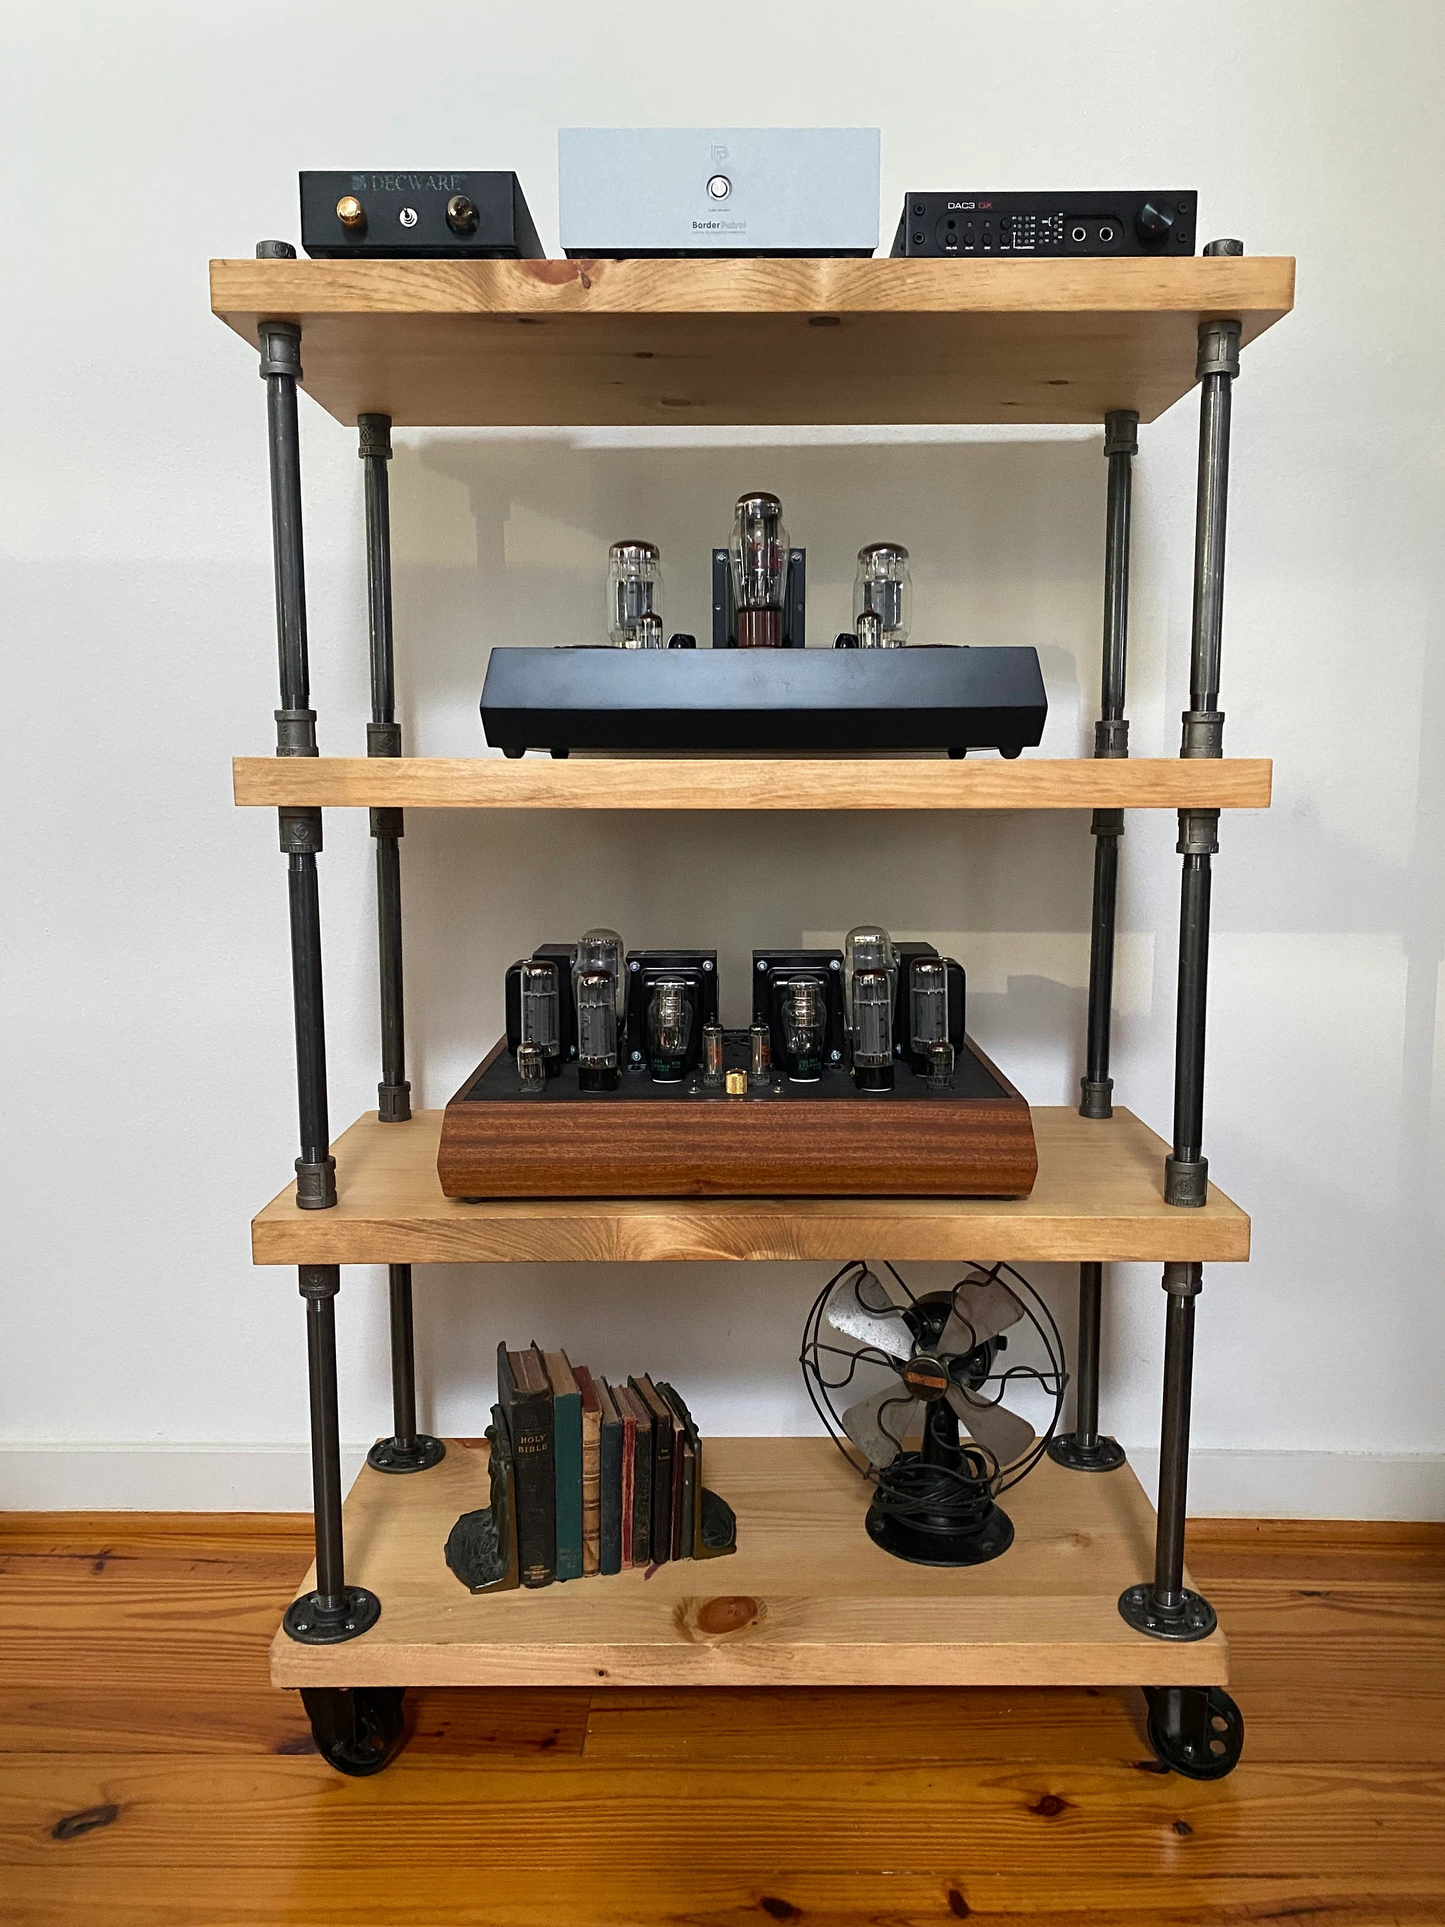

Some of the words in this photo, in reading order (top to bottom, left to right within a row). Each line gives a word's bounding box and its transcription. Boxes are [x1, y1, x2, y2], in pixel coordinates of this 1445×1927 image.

[372, 174, 461, 191] DECWARE
[947, 202, 976, 210] DAC3
[520, 1433, 547, 1444] HOLY
[518, 1443, 548, 1454] BIBLE
